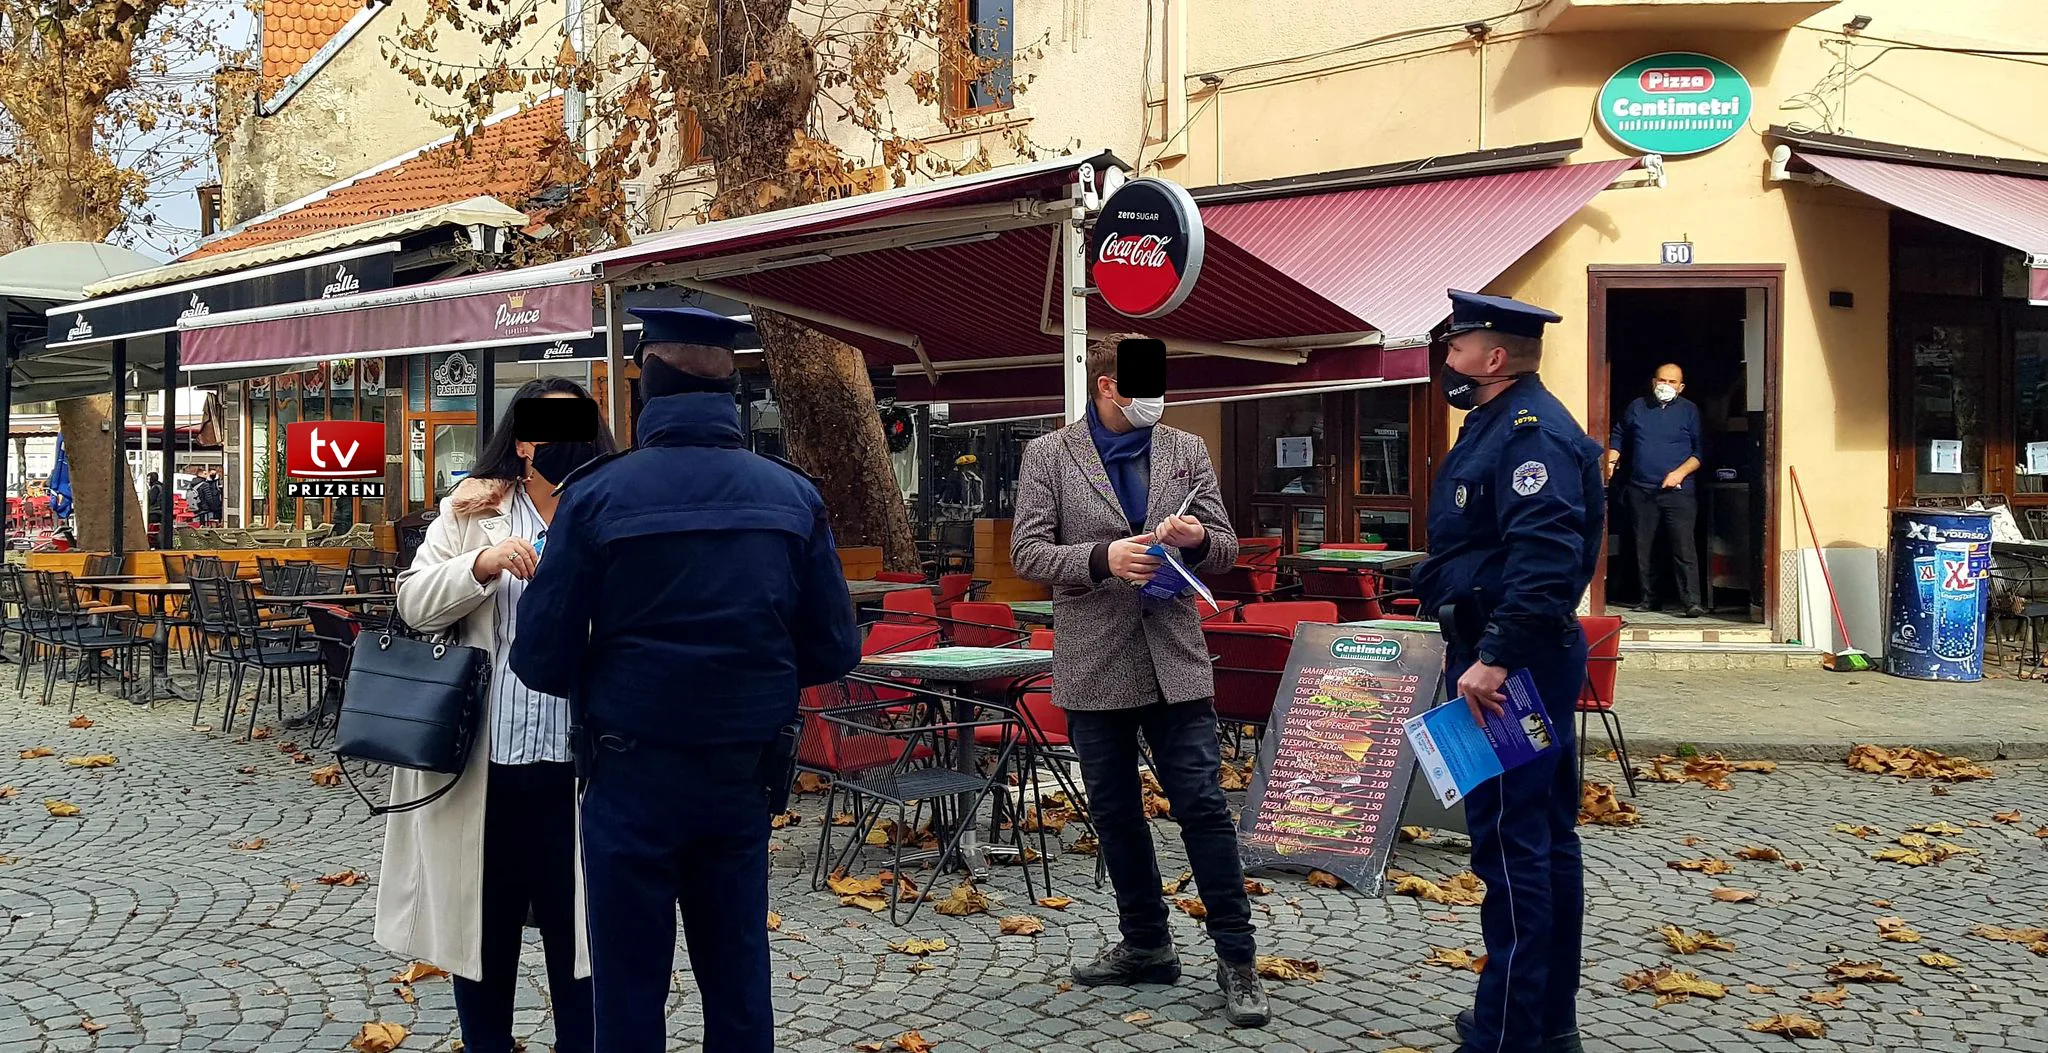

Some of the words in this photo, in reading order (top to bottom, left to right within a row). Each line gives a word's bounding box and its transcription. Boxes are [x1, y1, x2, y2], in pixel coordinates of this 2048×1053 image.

[1648, 71, 1704, 89] Pizza
[1612, 97, 1740, 117] Centimetri
[1117, 210, 1135, 219] zero
[1136, 212, 1159, 221] SUGAR
[1099, 232, 1173, 268] Coca-Cola
[1665, 245, 1689, 263] 60
[321, 274, 360, 299] galla
[494, 303, 540, 330] Prince
[67, 321, 93, 341] galla
[543, 343, 574, 359] galla
[436, 384, 476, 395] PASHTRIKU
[1448, 384, 1471, 397] POLICE
[1906, 520, 1946, 543] XL
[1919, 566, 1935, 580] XL
[1335, 643, 1397, 655] Centimetri
[1314, 678, 1345, 686] BURGER
[1295, 687, 1327, 695] CHICKEN
[1289, 707, 1329, 717] SANDWICH
[1285, 717, 1326, 727] SANDWICH
[1386, 727, 1403, 735] 1.50
[1282, 727, 1323, 738] SANDWICH
[1279, 738, 1318, 748] PLESKAVIC
[1374, 769, 1391, 777] 2.50
[1371, 780, 1388, 788] 2.00
[1367, 791, 1385, 799] 1.00
[1261, 800, 1282, 809] PIZZA
[1361, 813, 1379, 821] 2.00
[1364, 802, 1382, 810] 1.50
[1254, 822, 1272, 830] PIDE
[1355, 835, 1373, 843] 2.00
[1358, 824, 1376, 832] 2.00
[1352, 846, 1370, 854] 2.50
